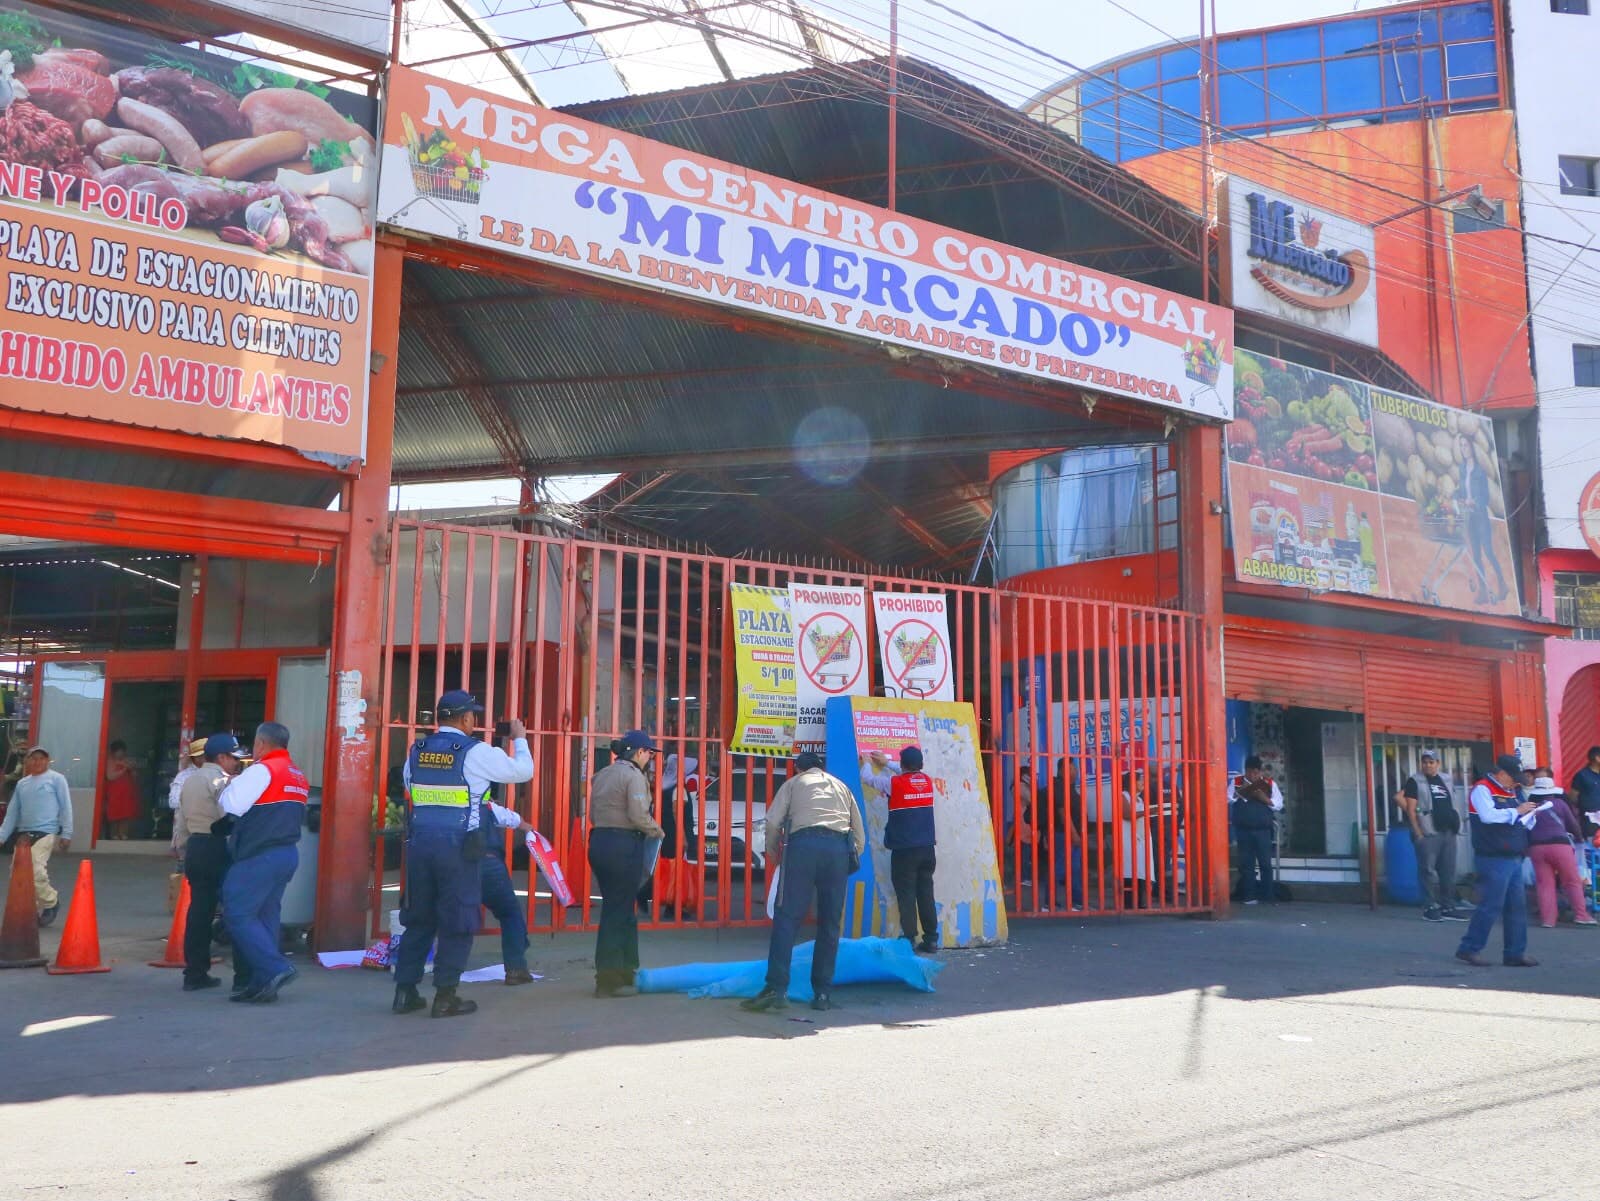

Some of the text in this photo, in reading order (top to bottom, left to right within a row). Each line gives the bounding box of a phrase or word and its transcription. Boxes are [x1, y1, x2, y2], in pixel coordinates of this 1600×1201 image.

[48, 170, 76, 208] Y
[80, 177, 189, 232] POLLO
[421, 83, 1216, 341] MEGA CENTRO COMERCIAL
[0, 219, 360, 324] PLAYA DE ESTACIONAMIENTO
[745, 225, 1131, 358] MERCADO”
[6, 272, 342, 367] EXCLUSIVO PARA CLIENTES
[478, 214, 1183, 404] LE DA LA BIENVENIDA Y AGRADECE SU PREFERENCIA
[0, 331, 351, 426] HIBIDO AMBULANTES
[1371, 390, 1448, 430] TUBERCULOS
[1243, 558, 1319, 587] ABARROTES
[794, 590, 863, 607] PROHIBIDO
[879, 597, 944, 614] PROHIBIDO
[737, 609, 791, 633] PLAYA
[800, 706, 827, 716] SACAR
[891, 728, 918, 738] TEMPORAL
[419, 752, 454, 764] SERENO
[415, 789, 458, 803] SERENAZGO
